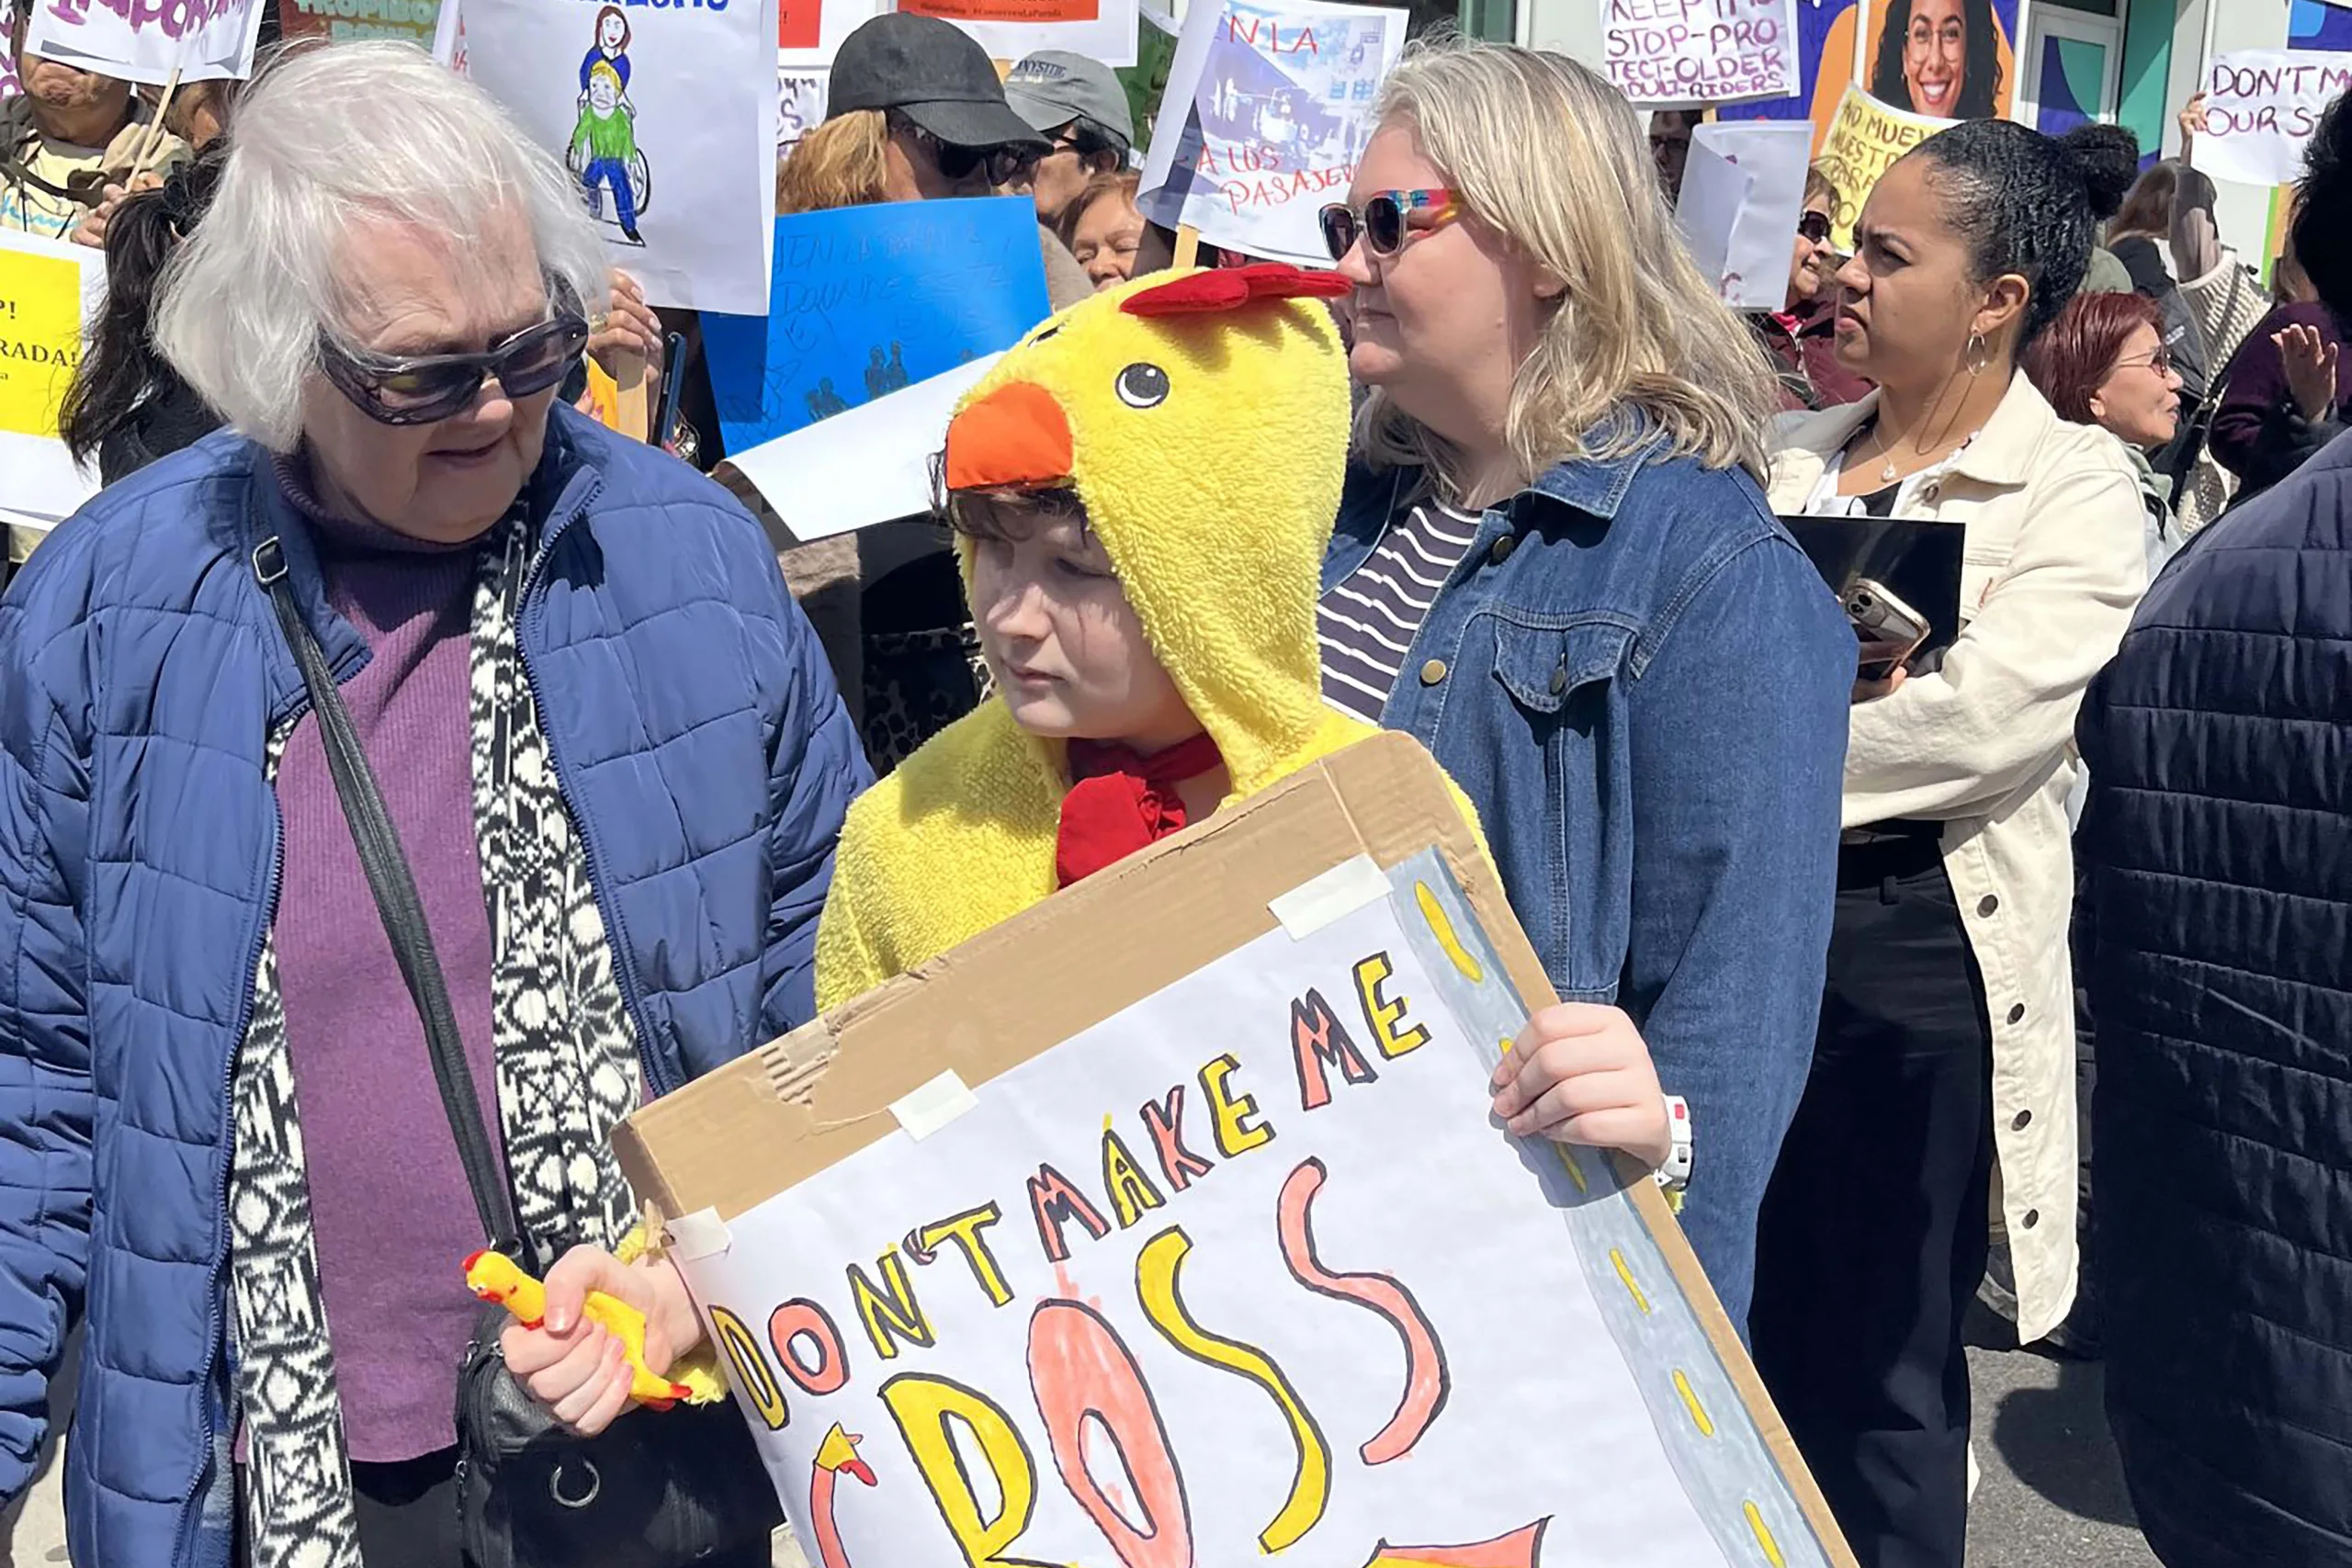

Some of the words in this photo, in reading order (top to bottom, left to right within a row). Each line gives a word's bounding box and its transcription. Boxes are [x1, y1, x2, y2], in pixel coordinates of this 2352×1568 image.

[1272, 22, 1318, 55] LA
[2213, 64, 2316, 97] DON'T
[2206, 106, 2279, 137] OUR
[708, 1199, 1016, 1432] DON'T
[1026, 1051, 1278, 1263] MAKE
[1291, 950, 1433, 1112] ME
